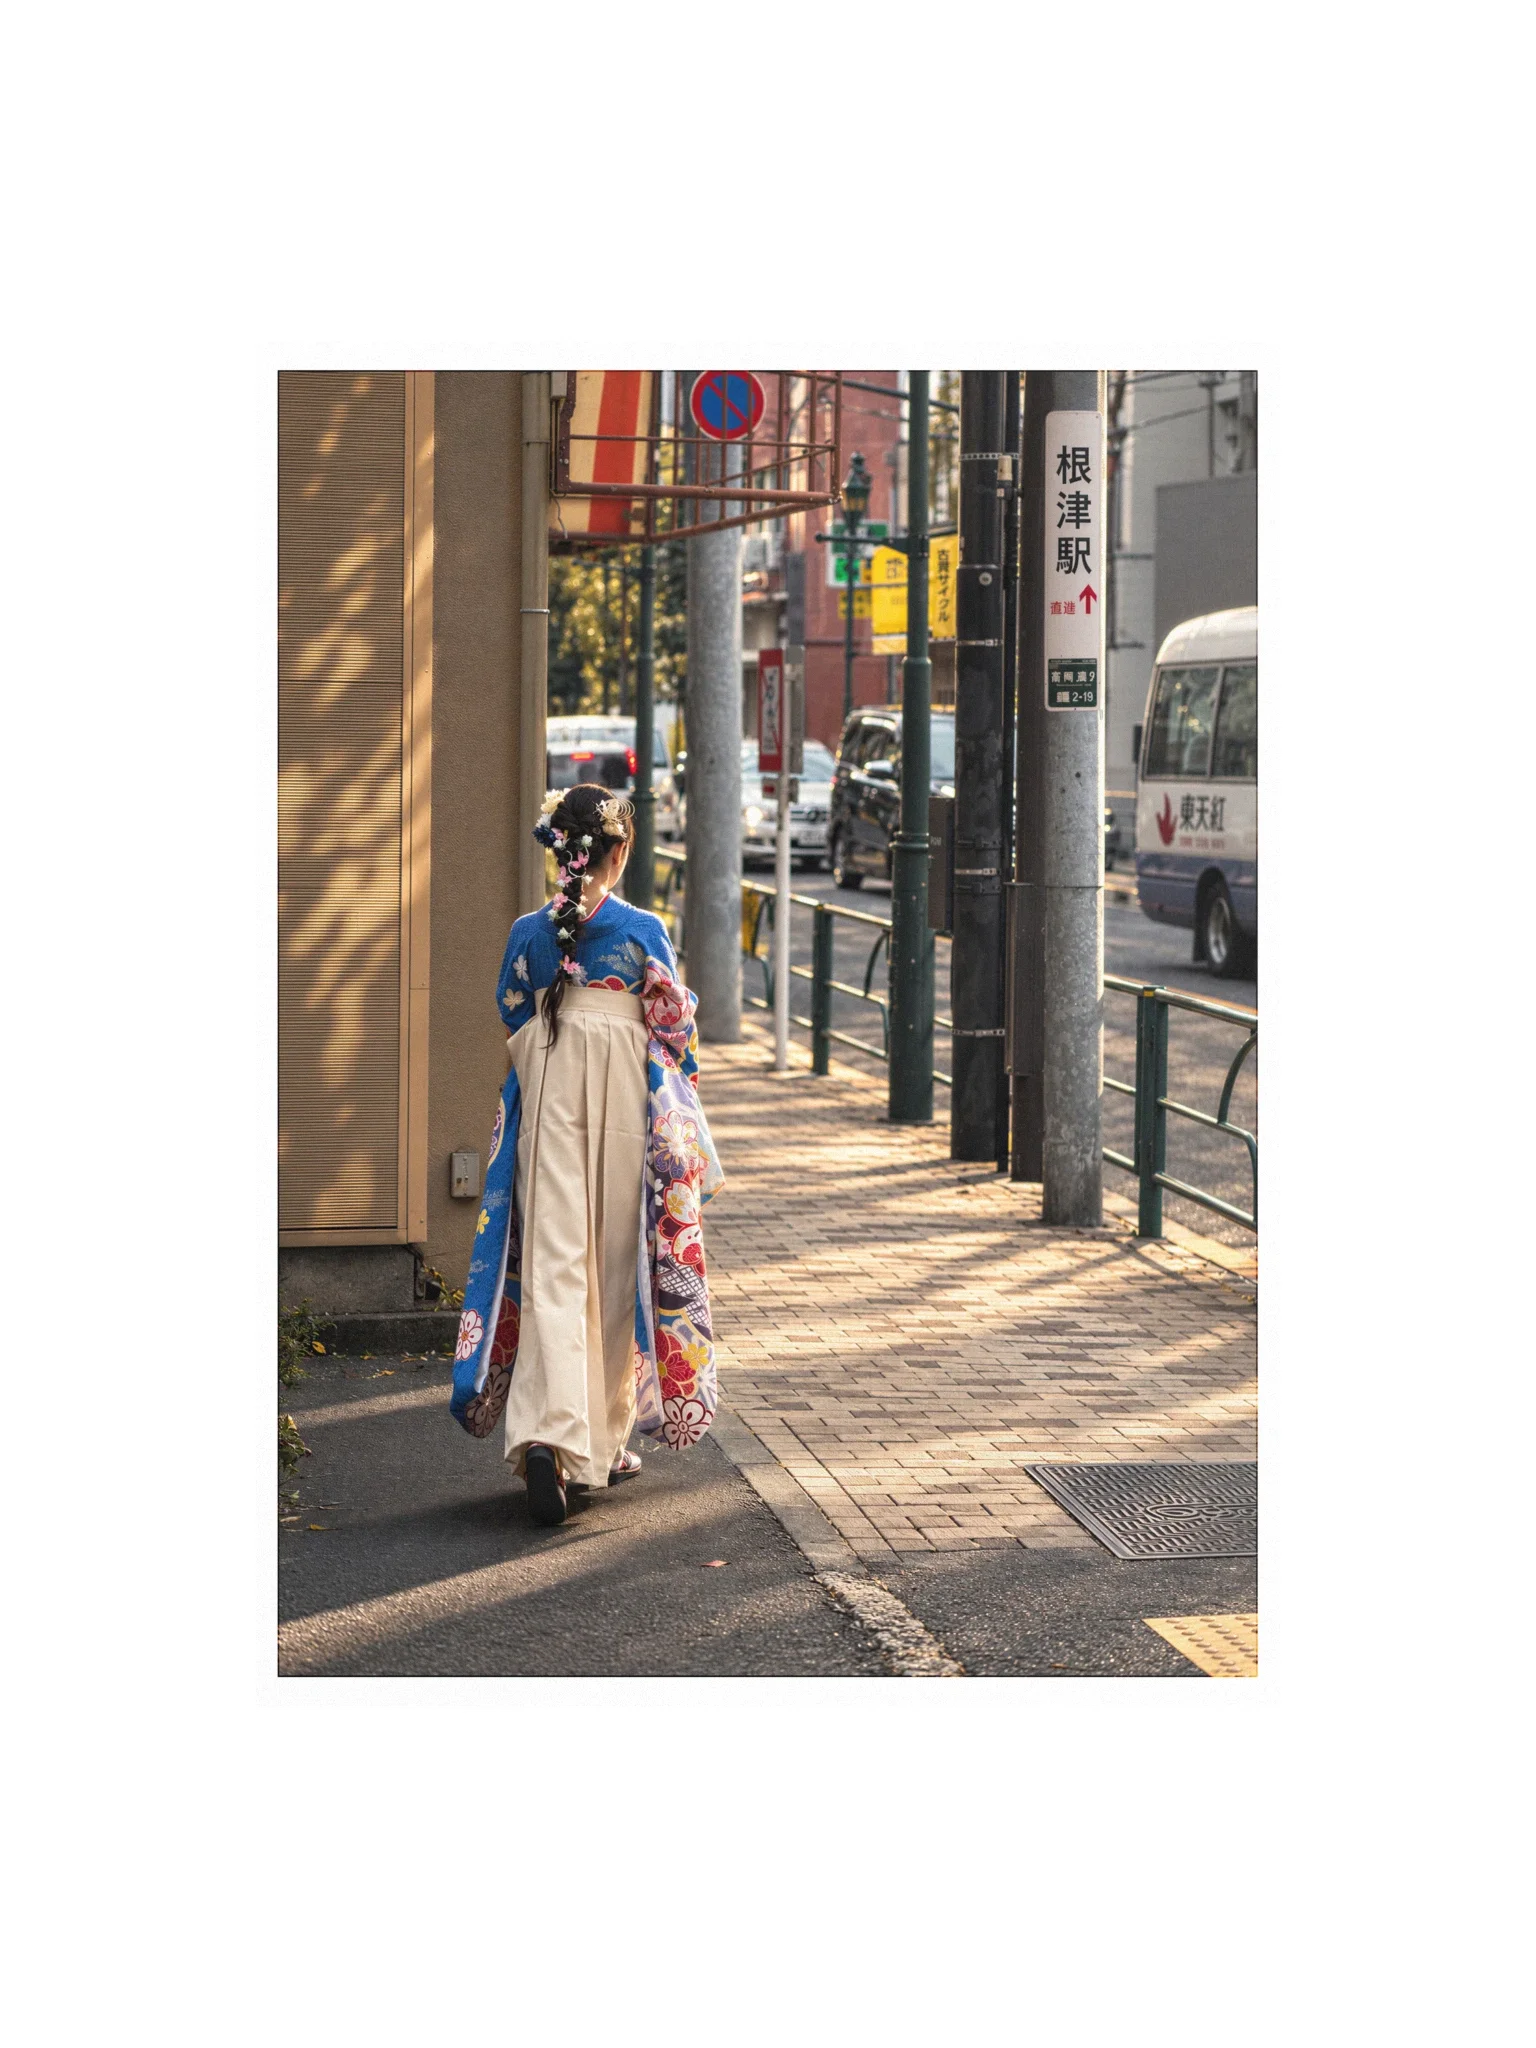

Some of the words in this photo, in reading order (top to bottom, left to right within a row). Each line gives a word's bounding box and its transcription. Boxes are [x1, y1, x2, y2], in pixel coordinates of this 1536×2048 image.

[1056, 444, 1092, 575] 根津駅
[1050, 600, 1076, 615] 直進
[1179, 793, 1227, 832] 東天紅
